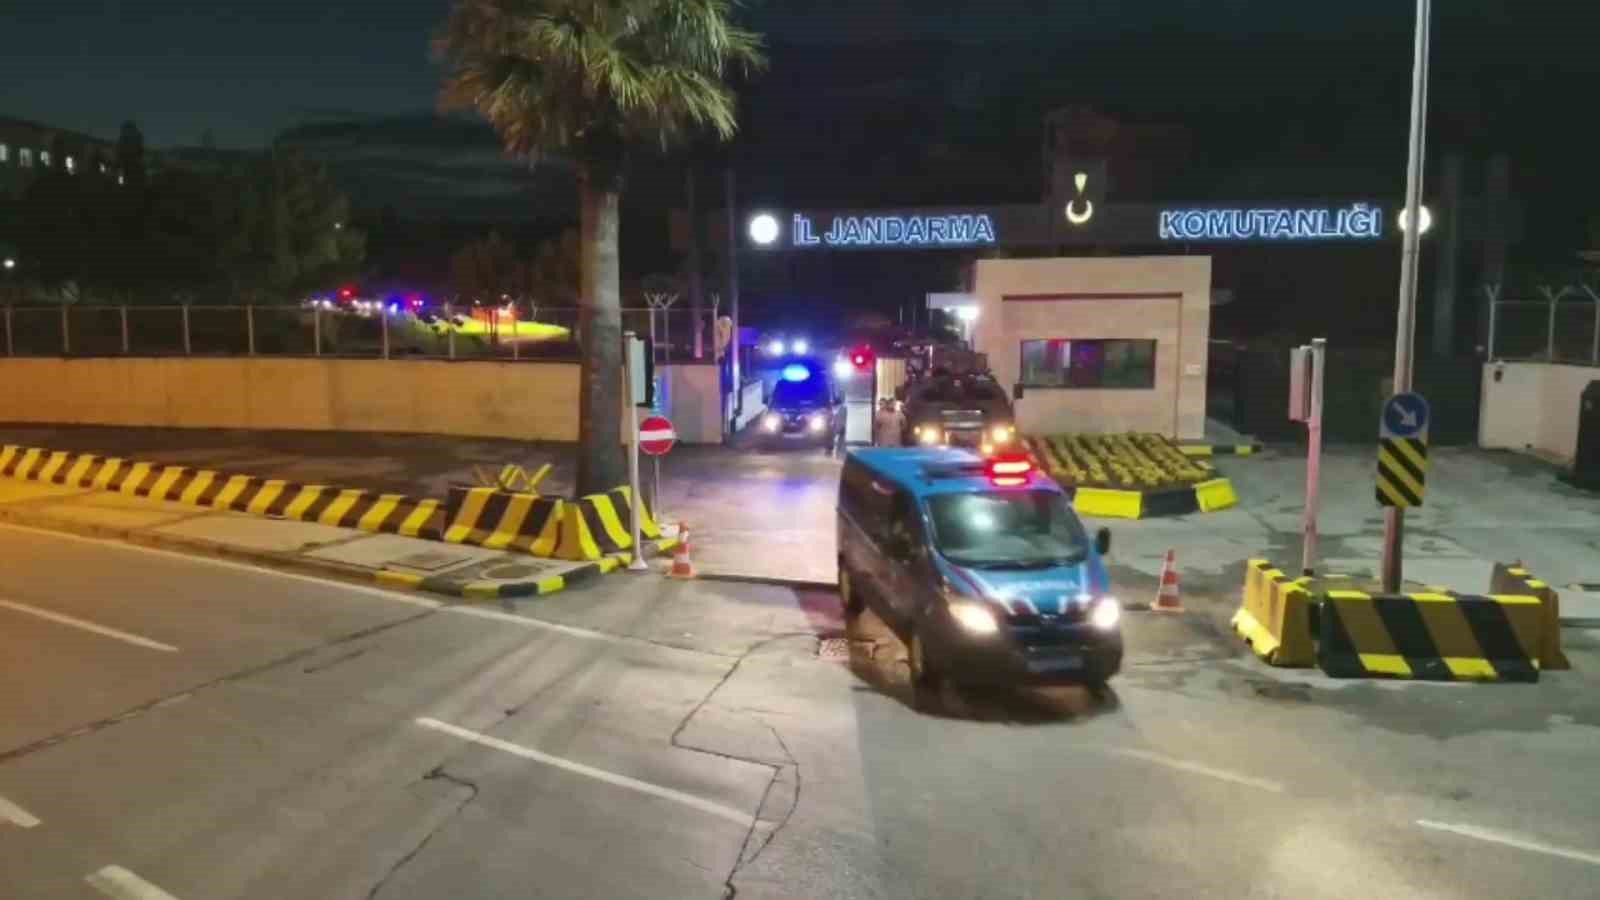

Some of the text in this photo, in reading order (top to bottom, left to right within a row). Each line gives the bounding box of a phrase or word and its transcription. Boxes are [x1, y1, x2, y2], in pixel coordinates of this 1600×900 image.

[793, 202, 1382, 246] İL JANDARMA KOMUTANLIĞI
